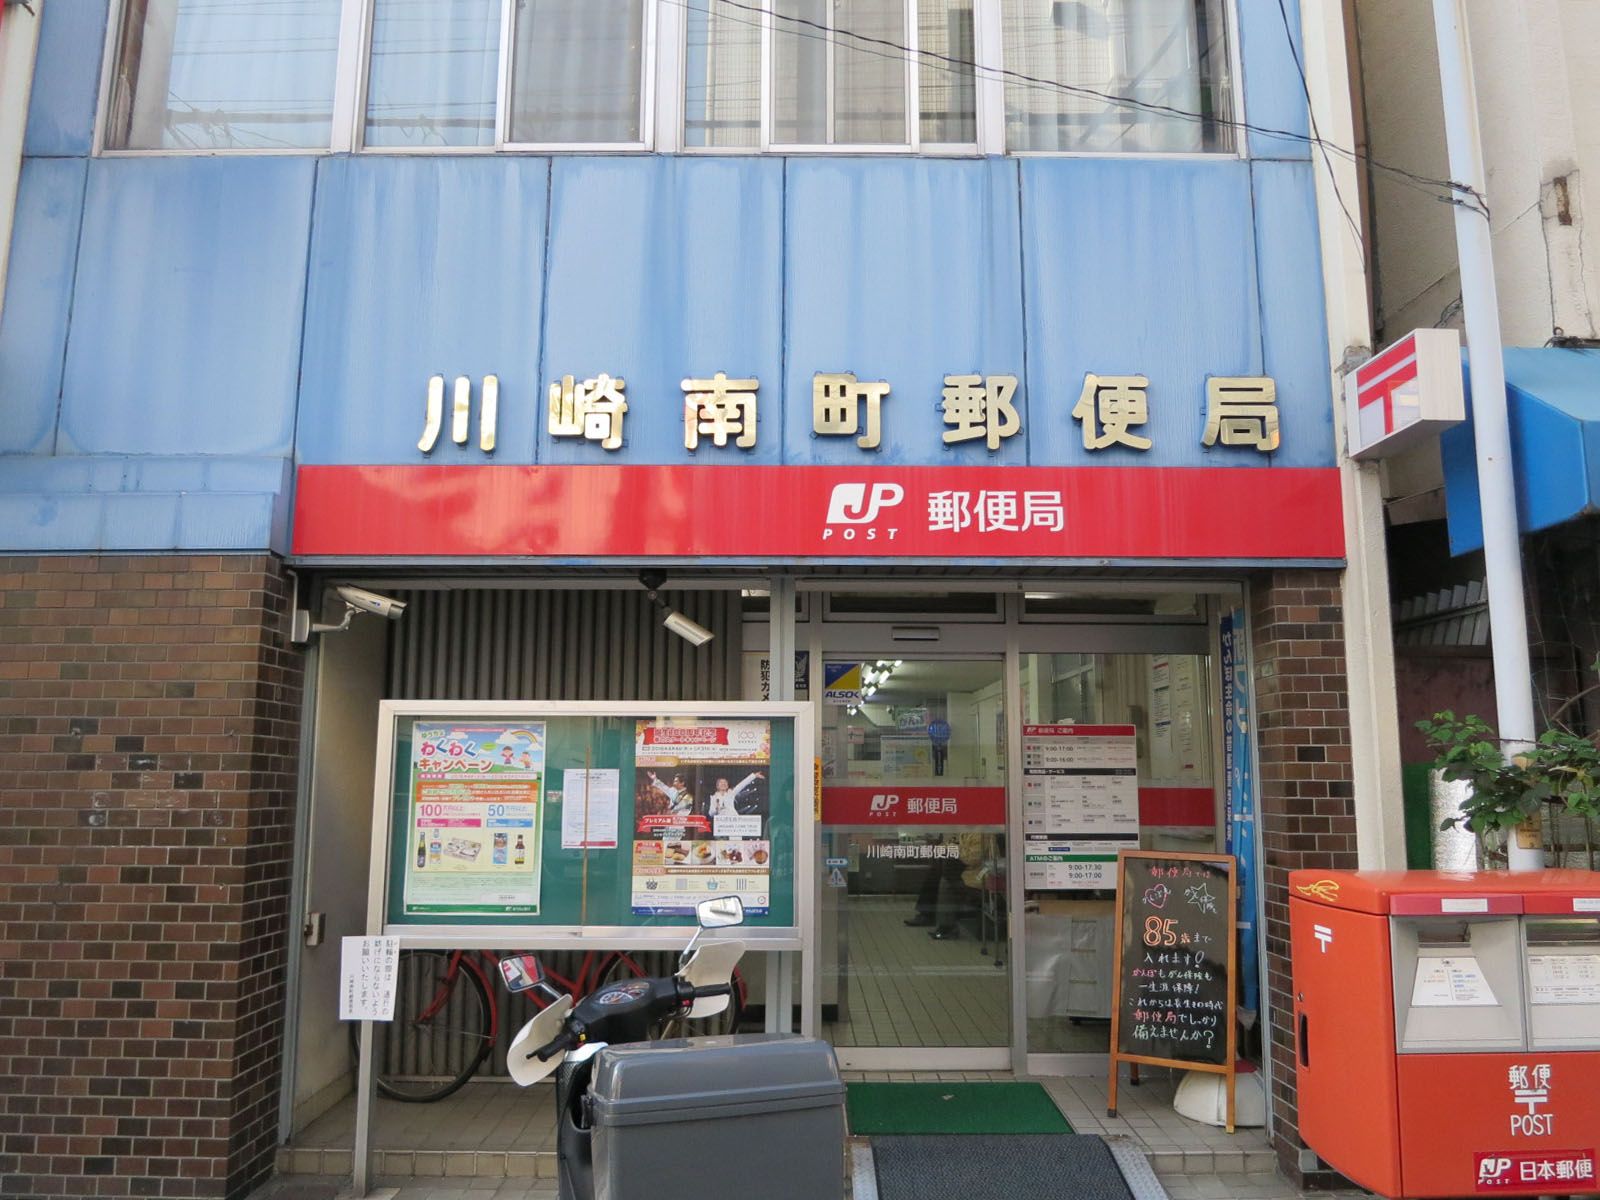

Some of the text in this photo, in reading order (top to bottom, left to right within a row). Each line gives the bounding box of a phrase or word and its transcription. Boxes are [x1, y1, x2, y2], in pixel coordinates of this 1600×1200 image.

[417, 373, 1280, 452] 川崎南町郵便局
[826, 483, 904, 523] JP
[928, 490, 1065, 533] 郵便局
[822, 528, 898, 540] POST
[420, 739, 477, 757] わくわく
[419, 758, 493, 772] キャンペーン
[907, 797, 958, 814] 郵便局
[866, 844, 960, 859] 川崎南町郵便局
[1508, 1063, 1552, 1089] 郵便
[1510, 1113, 1553, 1136] POST
[1520, 1158, 1594, 1181] 日本郵便
